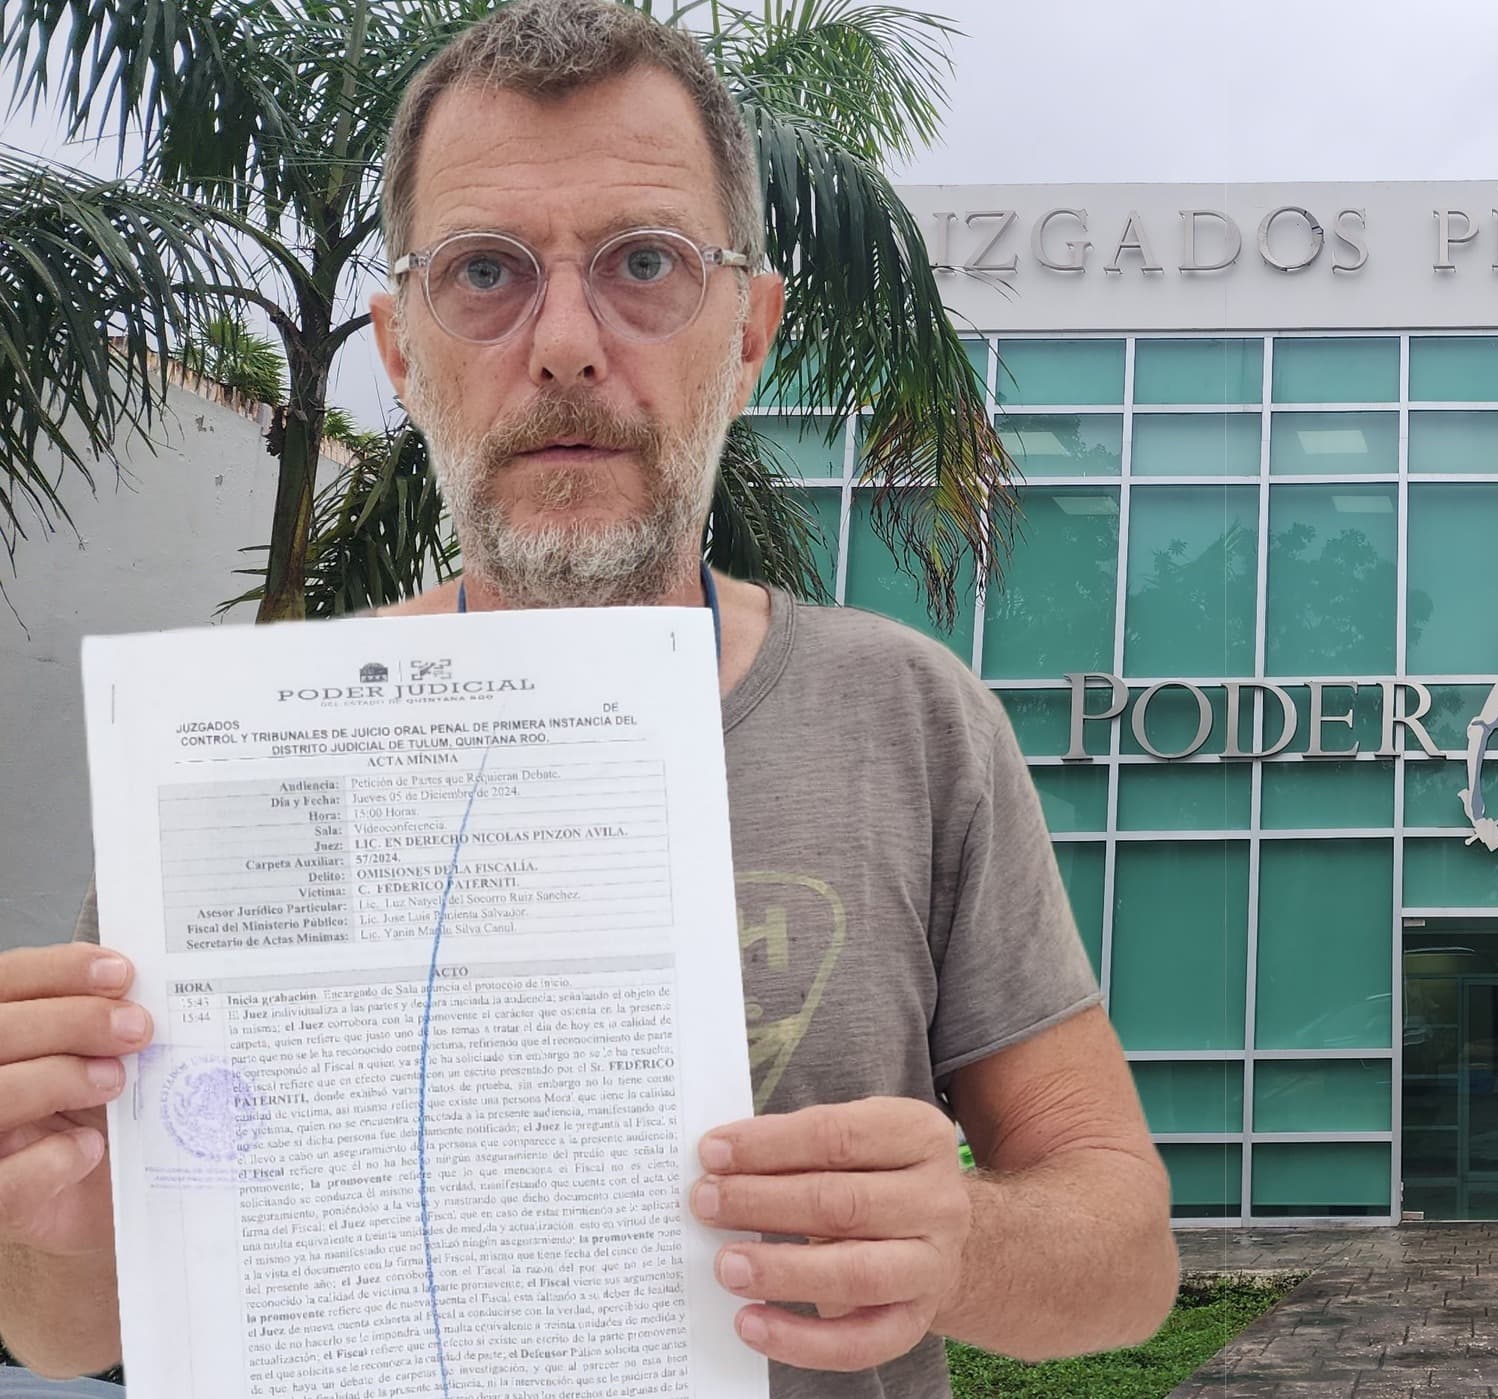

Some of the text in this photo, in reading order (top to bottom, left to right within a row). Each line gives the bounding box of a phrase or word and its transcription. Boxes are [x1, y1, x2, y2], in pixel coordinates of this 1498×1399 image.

[278, 679, 535, 701] PODER JUDICIAL
[406, 696, 465, 704] QUINTANA
[176, 702, 619, 734] JUZGADOS DE
[1061, 672, 1447, 760] PODER
[181, 715, 638, 747] CONTROL Y TRIBUNALES DE JUICIO ORAL PENAL DE PRIMERA INSTANCIA DEL
[271, 743, 328, 755] DISTRITO
[330, 741, 385, 753] JUDICIAL
[388, 740, 405, 750] DE
[455, 734, 517, 747] QUINTANA
[367, 752, 459, 768] ACTA MÍNIMA
[396, 776, 408, 786] de
[411, 775, 442, 785] Partes
[445, 775, 464, 787] que
[521, 769, 561, 781] Debate.
[279, 780, 340, 793] Audiencia:
[352, 792, 387, 804] Jueves
[405, 790, 418, 800] de
[420, 787, 473, 800] Diciembre
[476, 788, 489, 798] de
[491, 786, 520, 797] 2024.
[293, 799, 300, 809] y
[303, 795, 341, 806] Fecha:
[308, 811, 342, 822] Hora:
[314, 826, 343, 837] Sala:
[355, 837, 381, 849] LIC.
[385, 836, 402, 847] EN
[405, 833, 469, 847] DERECHO
[472, 830, 529, 843] NICOLAS
[314, 841, 344, 853] Juez:
[245, 856, 345, 873] Carpeta Auxiliar:
[355, 853, 401, 864] 57/2024.
[356, 858, 538, 880] OMISIONES DE LA FISCALÍA.
[308, 871, 346, 883] Delito:
[358, 884, 370, 895] C.
[377, 880, 443, 894] FEDERICO
[466, 892, 506, 904] Socorro
[197, 901, 348, 920] Asesor Jurídico Particular:
[187, 916, 349, 935] Fiscal del Ministerio Público:
[455, 923, 481, 934] Silva
[186, 938, 243, 950] Secretario
[246, 936, 260, 946] de
[263, 935, 294, 946] Actas
[433, 967, 469, 978] ACTO
[174, 983, 213, 994] HORA
[227, 995, 259, 1006] Inicia
[396, 985, 418, 995] Sala
[242, 1008, 268, 1020] Juez
[299, 1020, 324, 1031] Juez
[608, 1058, 675, 1071] FEDERICO
[535, 1121, 560, 1132] Juez
[252, 1167, 285, 1179] Fiscal
[327, 1174, 392, 1189] promovente
[341, 1220, 365, 1231] Juez
[592, 1230, 655, 1245] promovente
[355, 1276, 380, 1286] Juez
[260, 1309, 325, 1324] promovente
[260, 1326, 285, 1337] Juez
[336, 1349, 368, 1360] Fiscal
